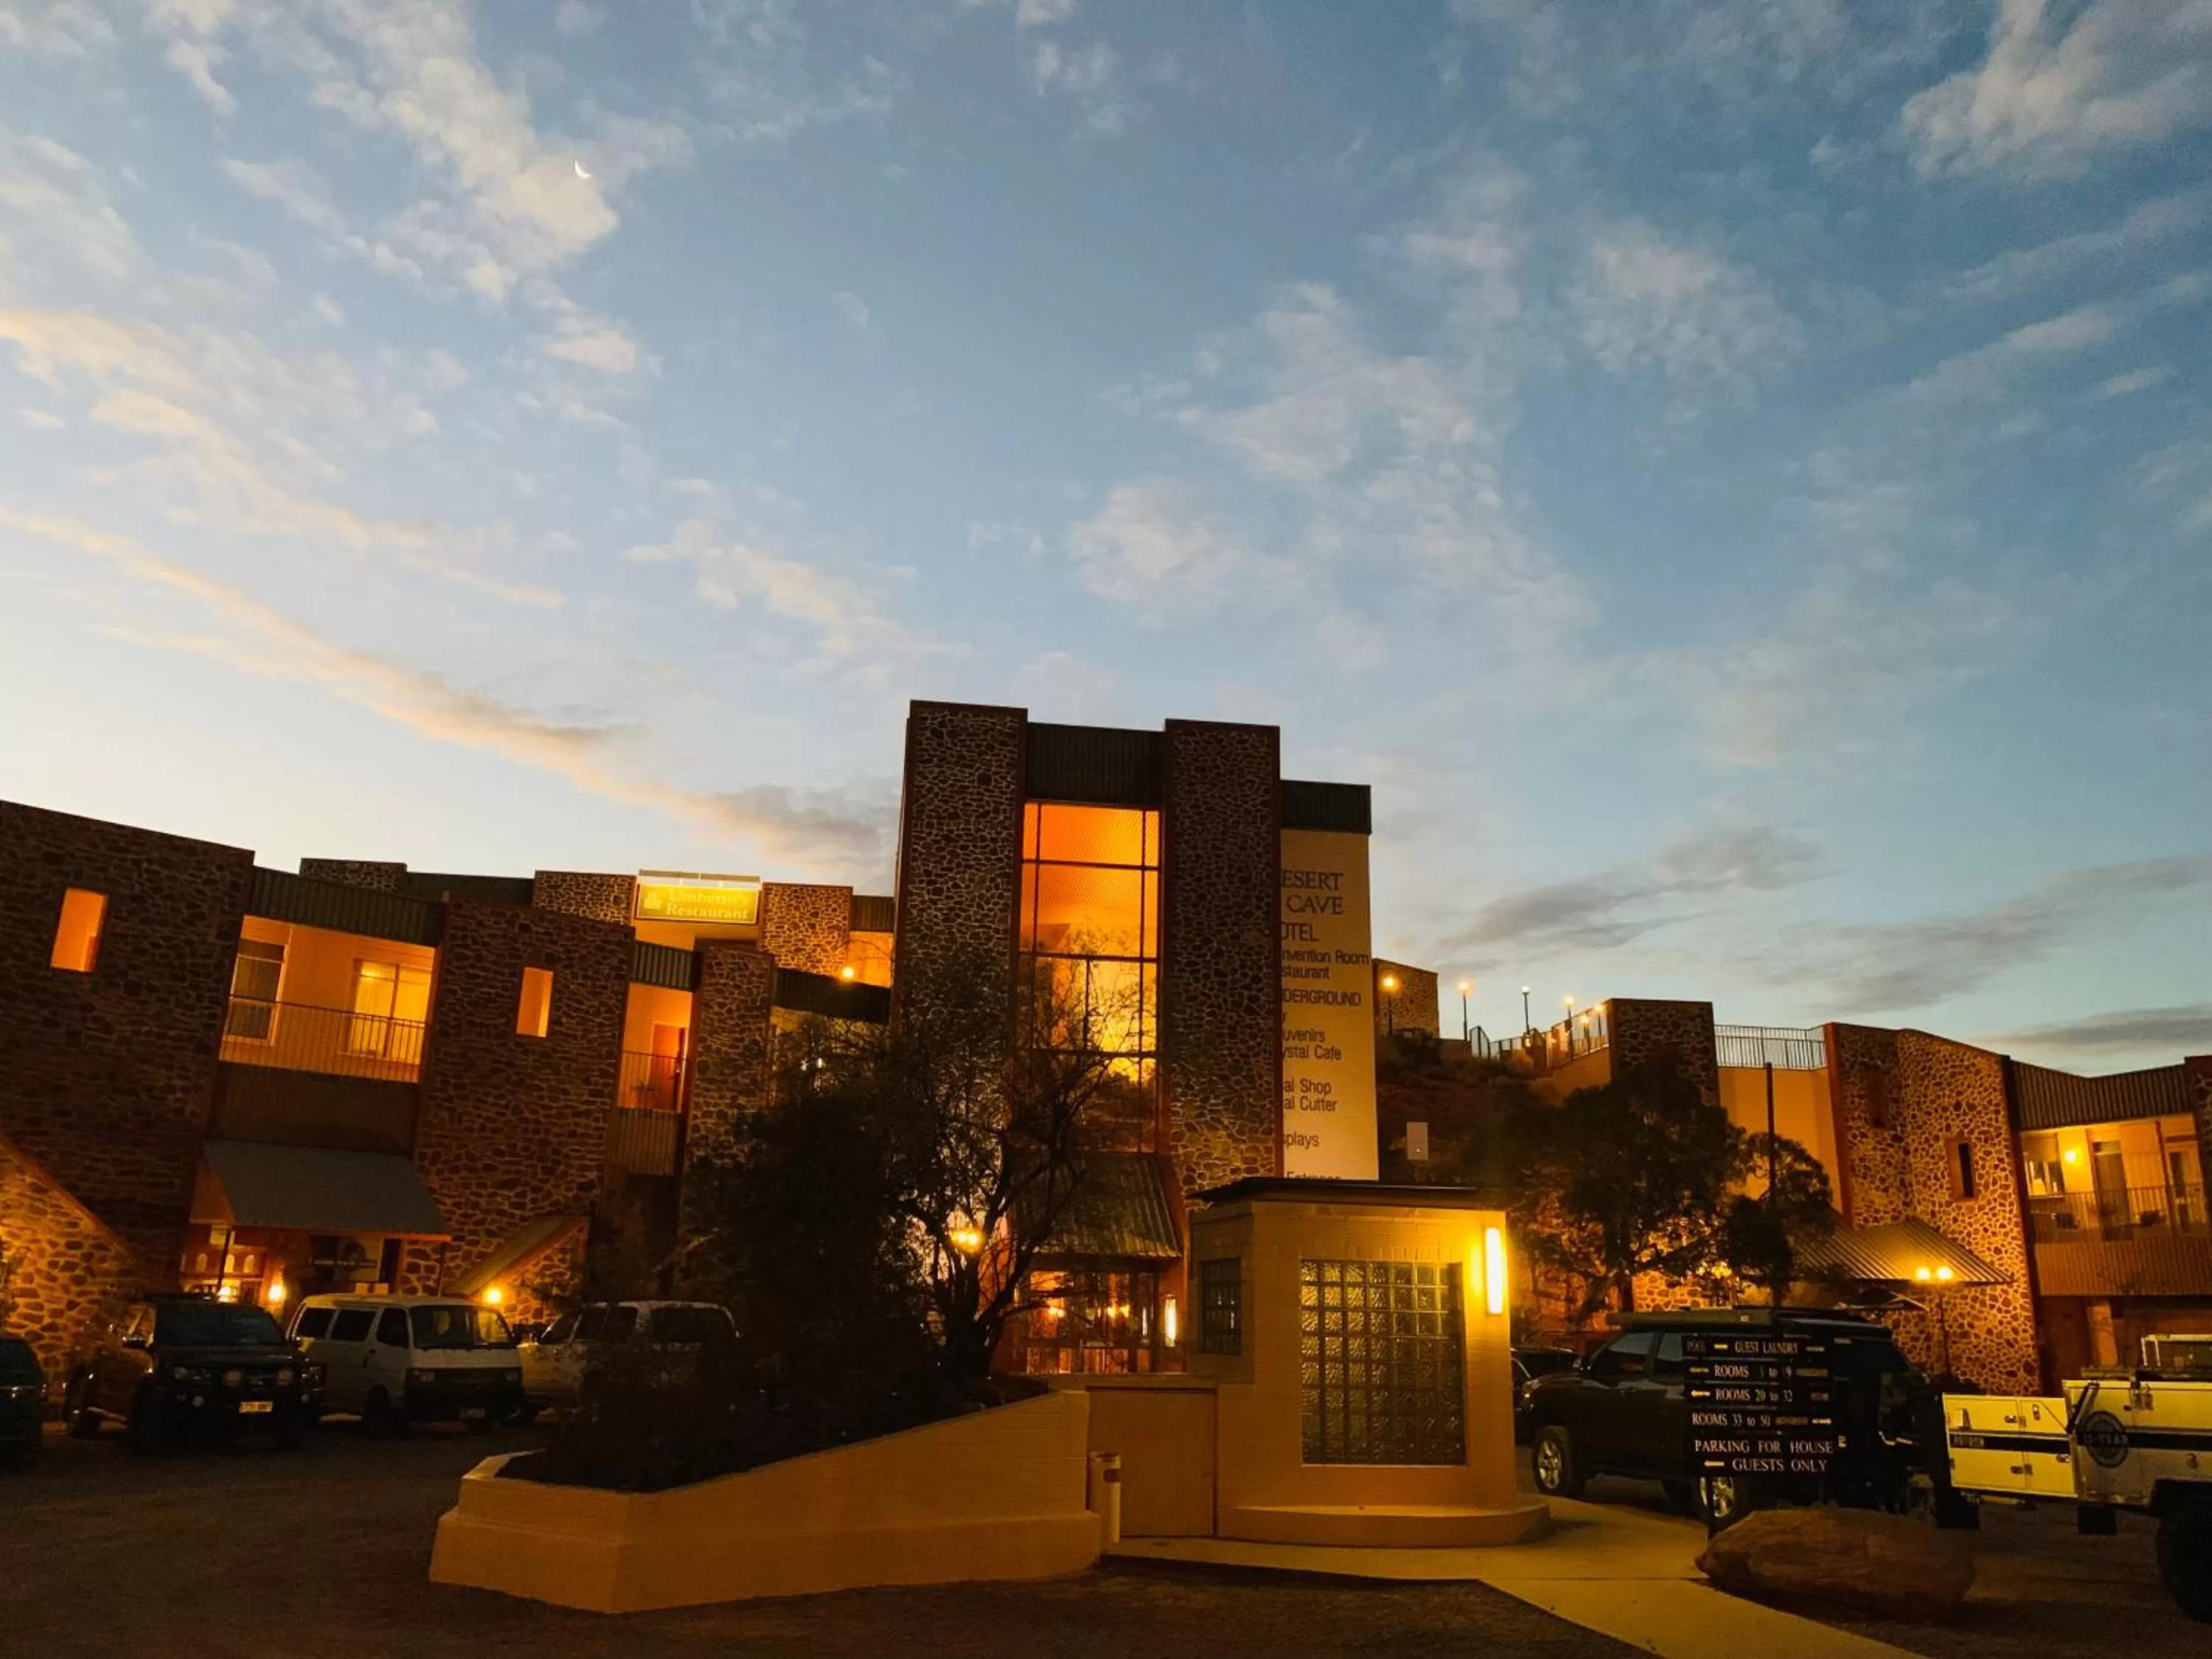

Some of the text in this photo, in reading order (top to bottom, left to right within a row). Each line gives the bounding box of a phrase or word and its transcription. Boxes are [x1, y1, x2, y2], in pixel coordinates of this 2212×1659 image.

[1281, 871, 1344, 890] ESERT
[669, 889, 748, 903] Umberto's
[667, 902, 748, 919] Restaurant
[1287, 894, 1344, 914] CAVE
[1281, 922, 1318, 942] OTEL
[1283, 949, 1330, 963] nvention
[1281, 964, 1330, 979] staurant
[1281, 989, 1361, 1006] DERGROUND
[1282, 1029, 1325, 1043] uvenirs
[1282, 1044, 1342, 1060] ystal Cafe
[1284, 1077, 1332, 1096] al Shop
[1284, 1096, 1338, 1112] al Cutter
[1735, 1341, 1798, 1354] GUEST LAUNDRY
[1714, 1365, 1749, 1378] ROOMS
[1769, 1368, 1778, 1377] to
[1716, 1389, 1750, 1401] ROOMS
[1770, 1393, 1778, 1401] to
[1692, 1413, 1728, 1426] ROOMS
[1732, 1413, 1742, 1426] 33
[1747, 1416, 1756, 1426] to
[1694, 1439, 1834, 1454] PARKING FOR HOUSE
[1733, 1458, 1827, 1472] GUESTS ONLY
